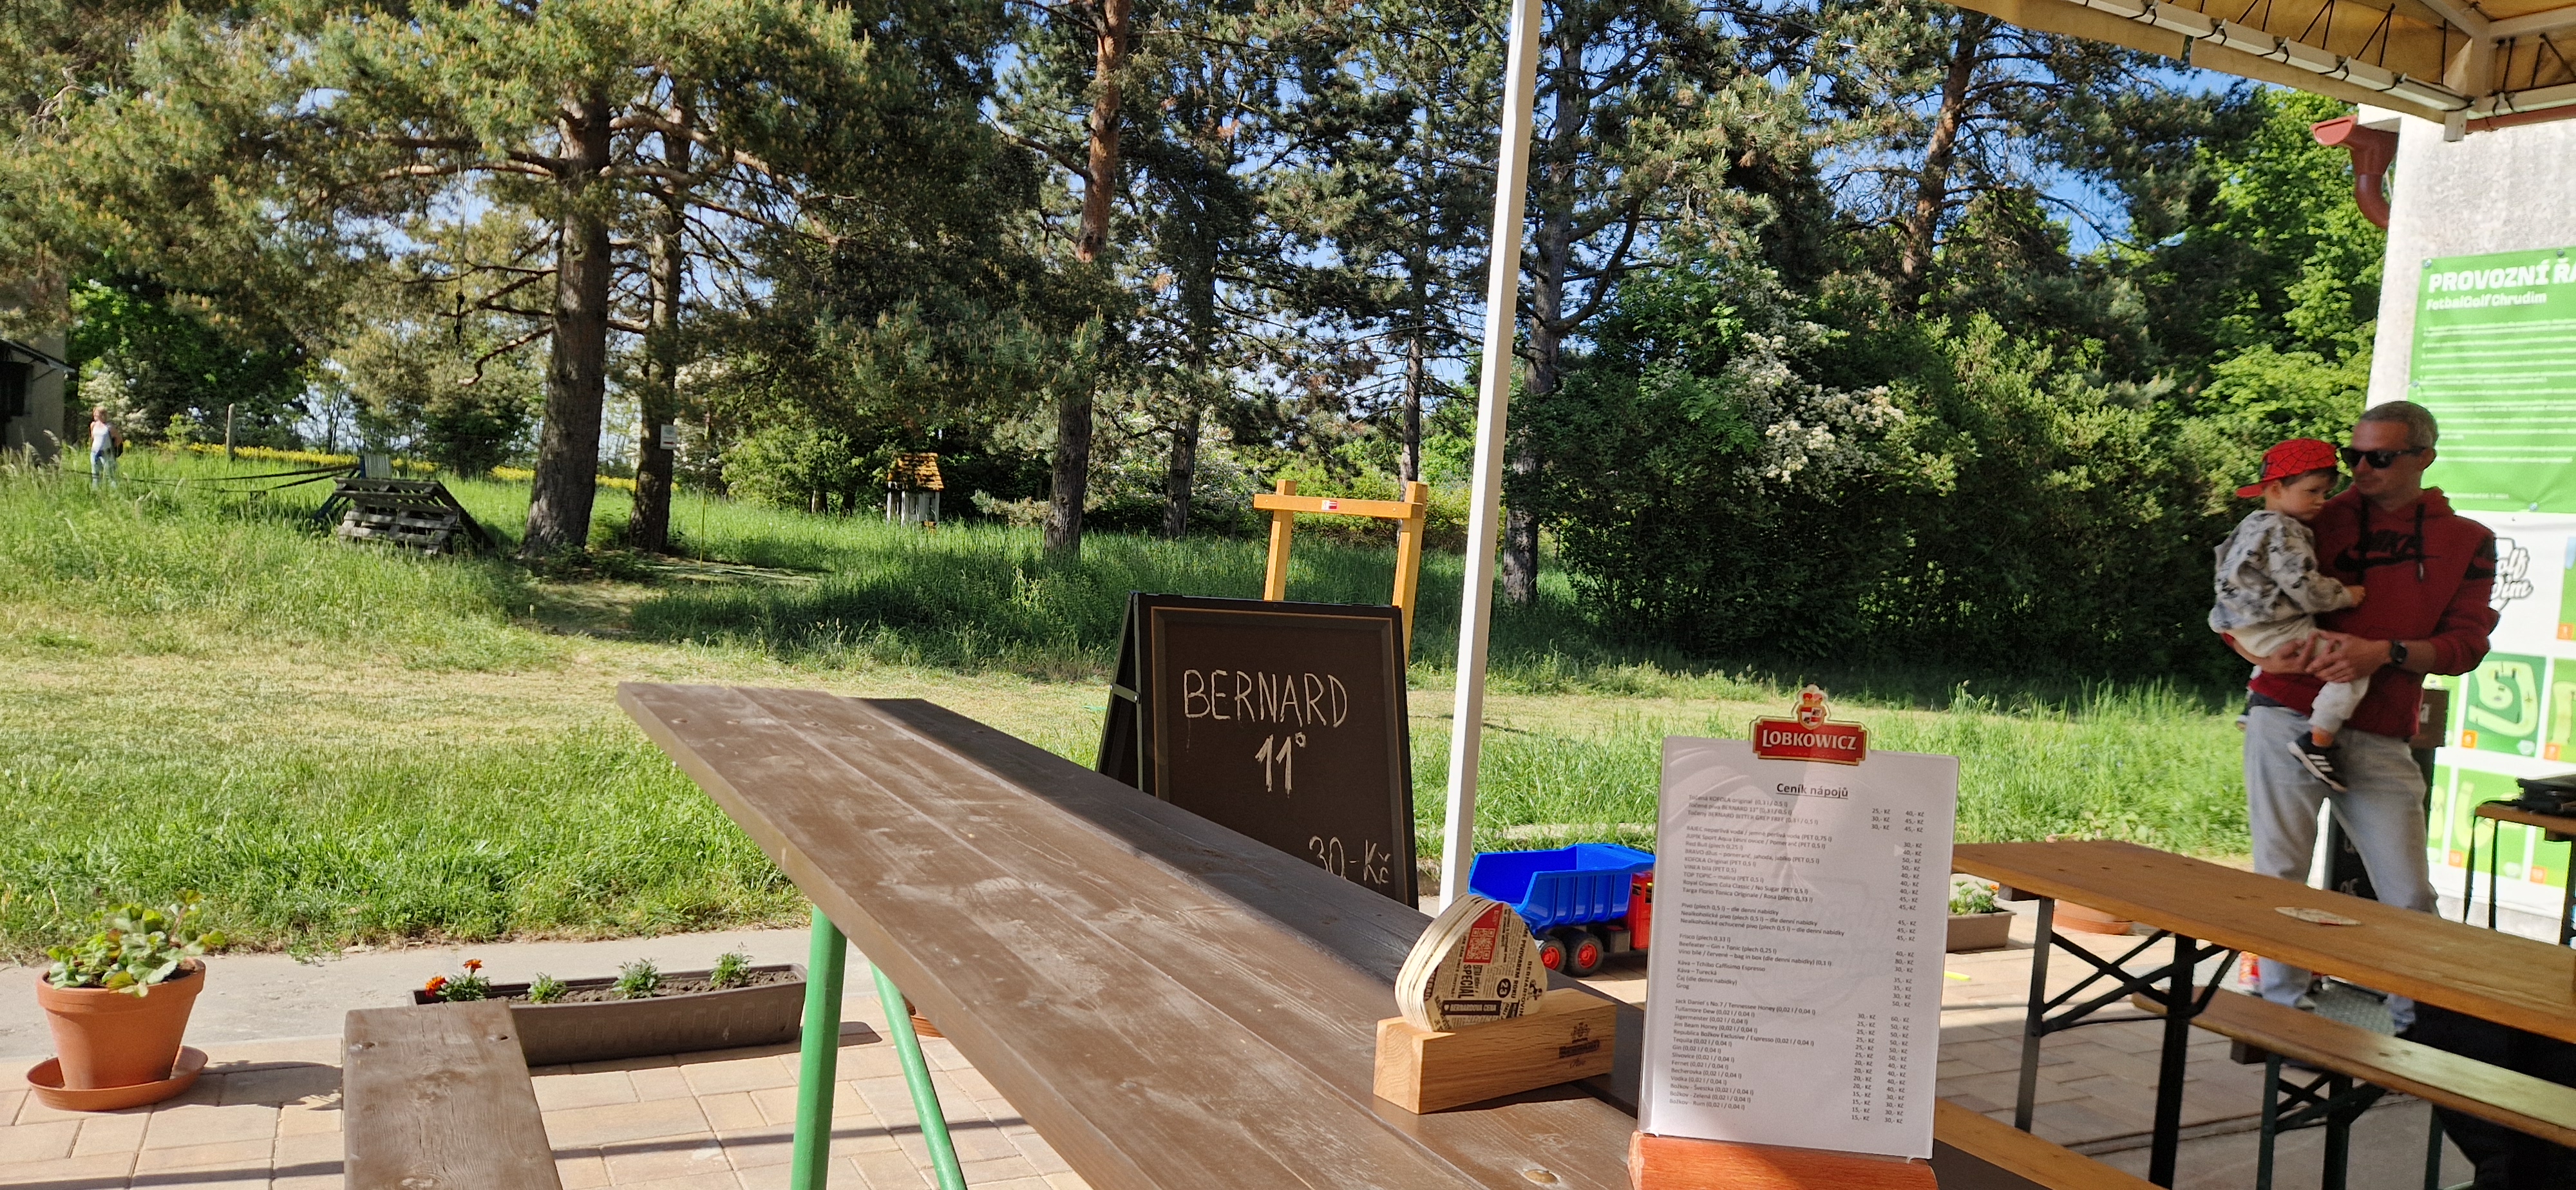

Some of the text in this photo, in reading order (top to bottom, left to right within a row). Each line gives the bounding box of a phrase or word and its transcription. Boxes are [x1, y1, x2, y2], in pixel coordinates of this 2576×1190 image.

[2429, 259, 2550, 293] PROVOZNÍ
[1183, 669, 1348, 728] BERNARD
[1762, 729, 1857, 750] LOBKOWICZ
[1255, 732, 1307, 798] 11°
[1777, 783, 1849, 798] Ceník nápojů
[1363, 839, 1391, 884] Kč
[1515, 940, 1526, 978] PIVOVAREM
[1457, 965, 1479, 999] SPECIÁL
[1499, 980, 1509, 996] 23
